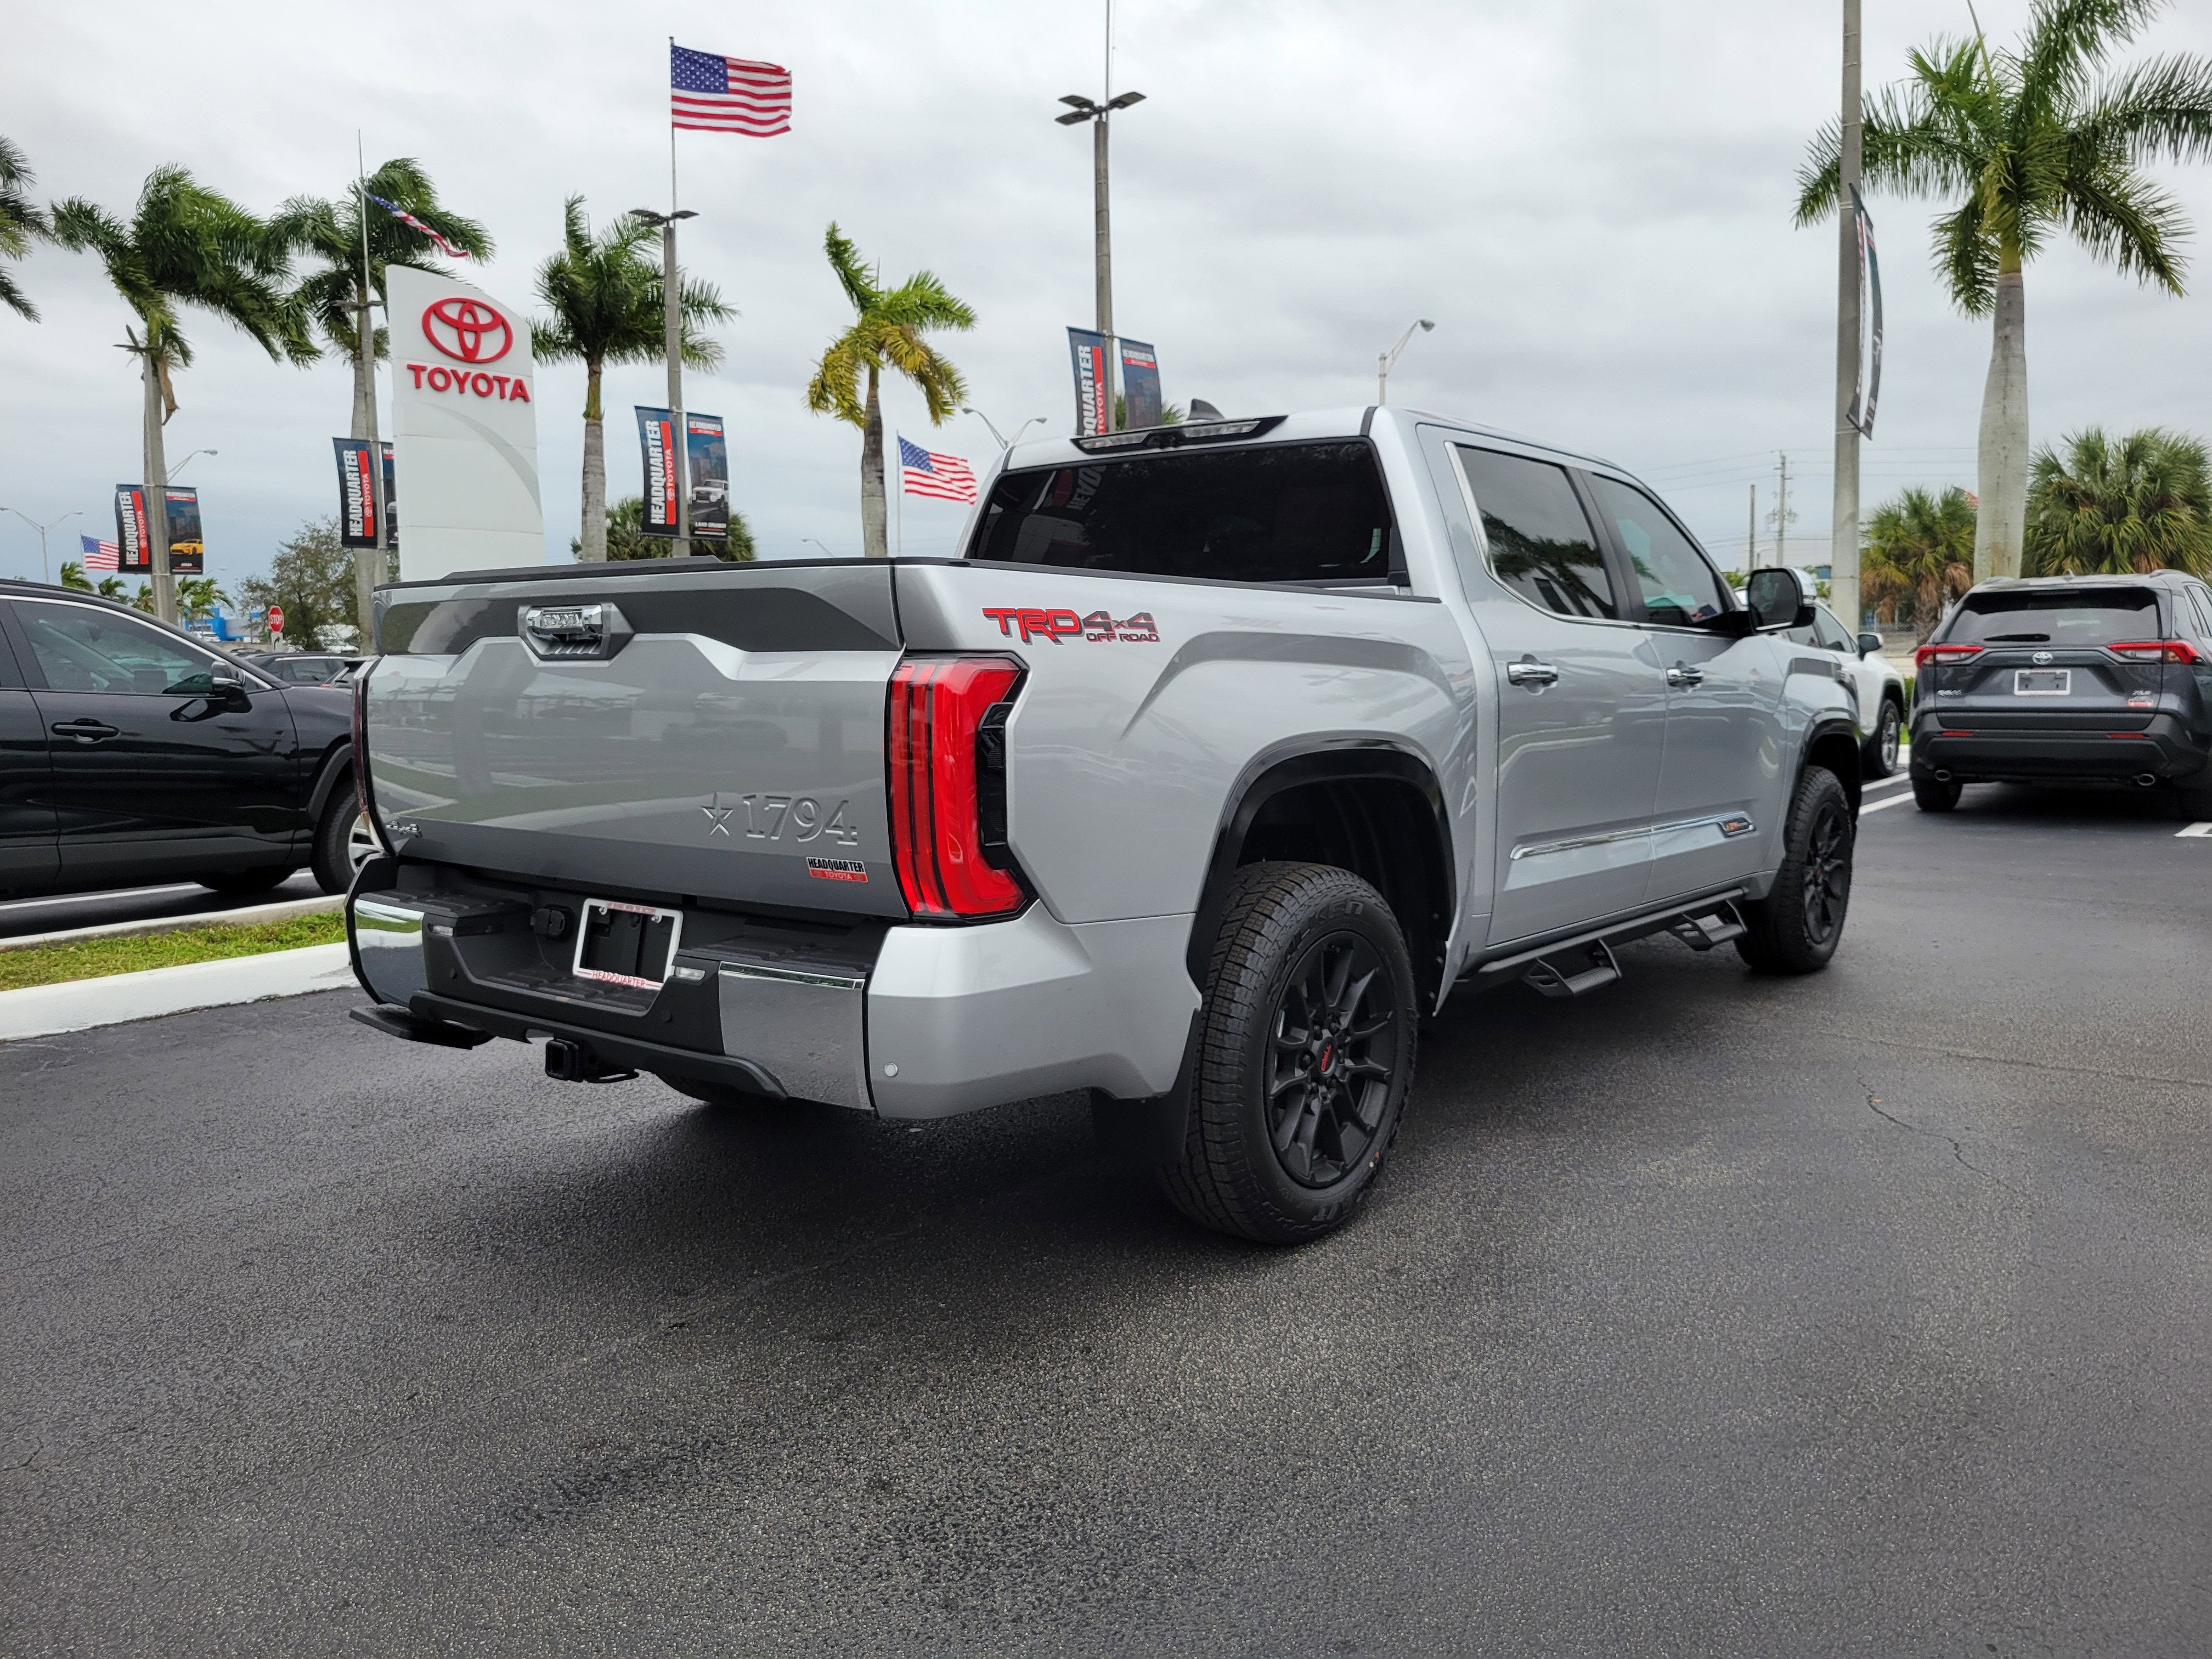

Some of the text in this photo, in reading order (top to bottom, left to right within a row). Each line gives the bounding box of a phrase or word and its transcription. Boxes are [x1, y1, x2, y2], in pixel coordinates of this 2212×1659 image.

[407, 364, 531, 402] TOYOTA
[645, 420, 666, 524] HEADQUARTER
[664, 448, 674, 486] TOYOTA
[343, 450, 363, 537] HEADQUARTER
[363, 473, 371, 506] TOYOTA
[119, 491, 138, 565] HEADQUARTER
[137, 510, 147, 538] TOYOTA
[270, 614, 283, 625] STOP
[982, 607, 1084, 645] TRD
[1086, 633, 1160, 642] OFF ROAD
[743, 794, 858, 846] 1794
[808, 857, 865, 873] HEADQUARTER
[825, 871, 853, 881] TOYOTA
[592, 969, 646, 988] HEADQUARTER
